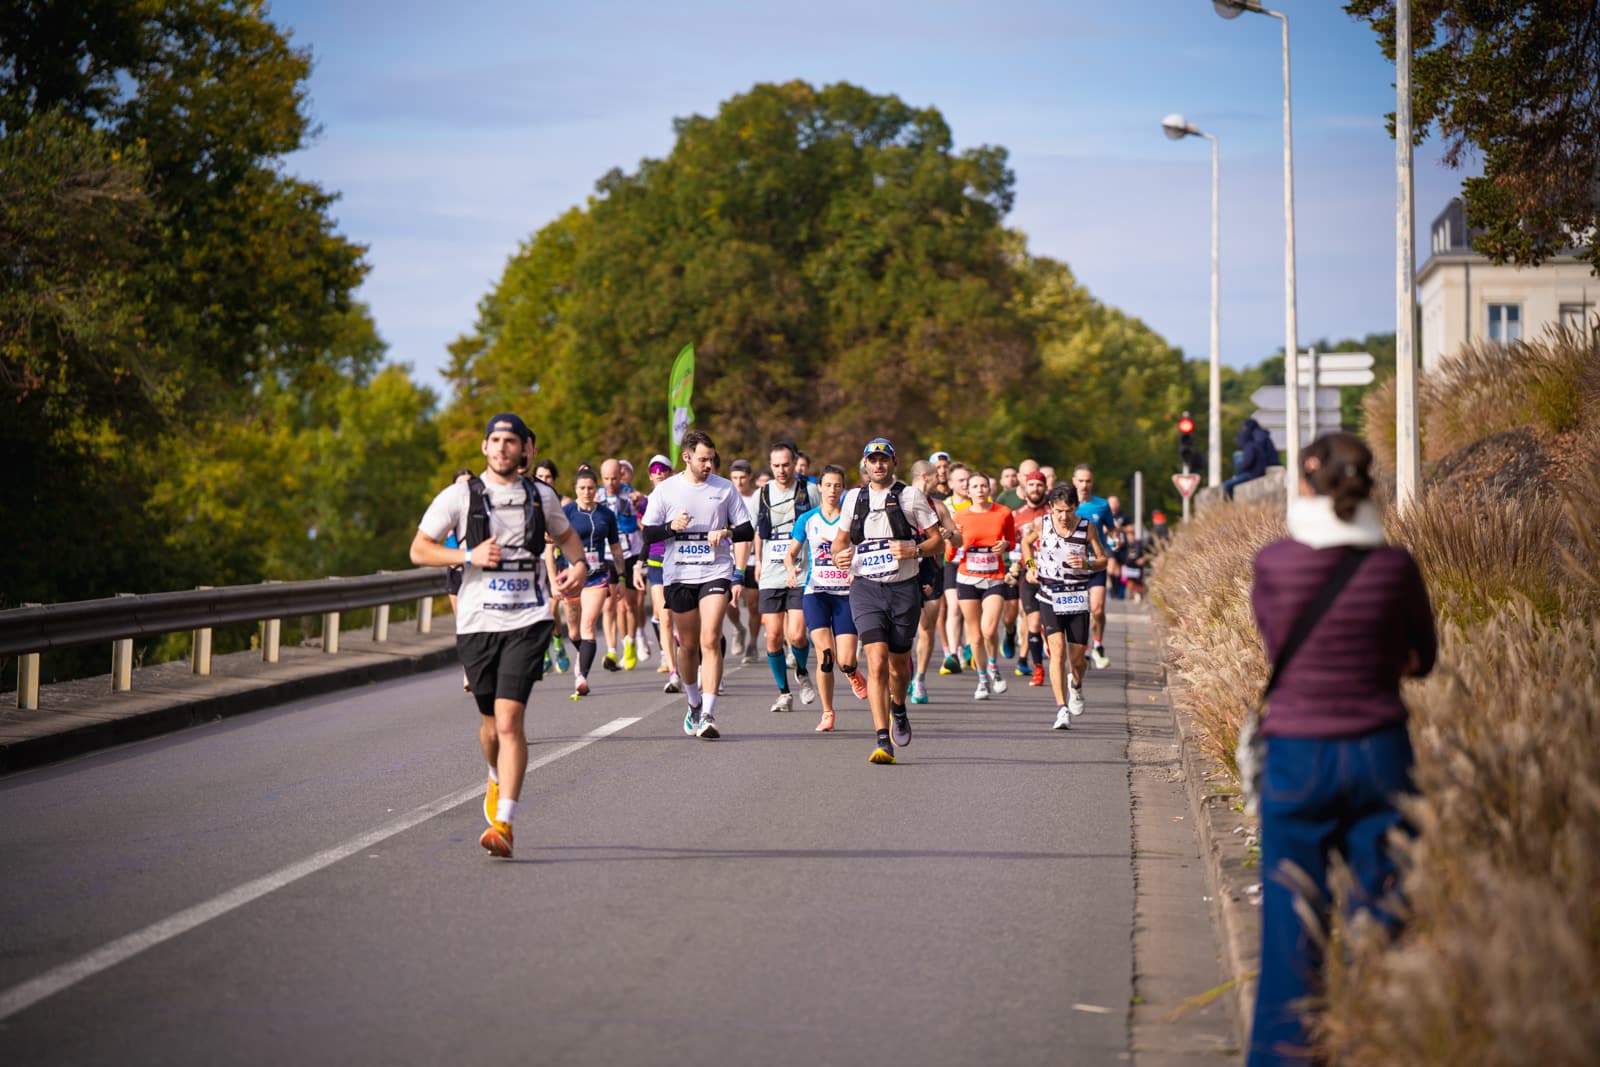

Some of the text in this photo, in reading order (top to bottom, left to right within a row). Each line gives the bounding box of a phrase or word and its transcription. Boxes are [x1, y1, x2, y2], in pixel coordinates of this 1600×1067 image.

[678, 545, 710, 555] 44058
[862, 553, 893, 567] 42219
[818, 570, 849, 579] 43936
[488, 578, 529, 592] 42639
[1056, 595, 1085, 605] 43820
